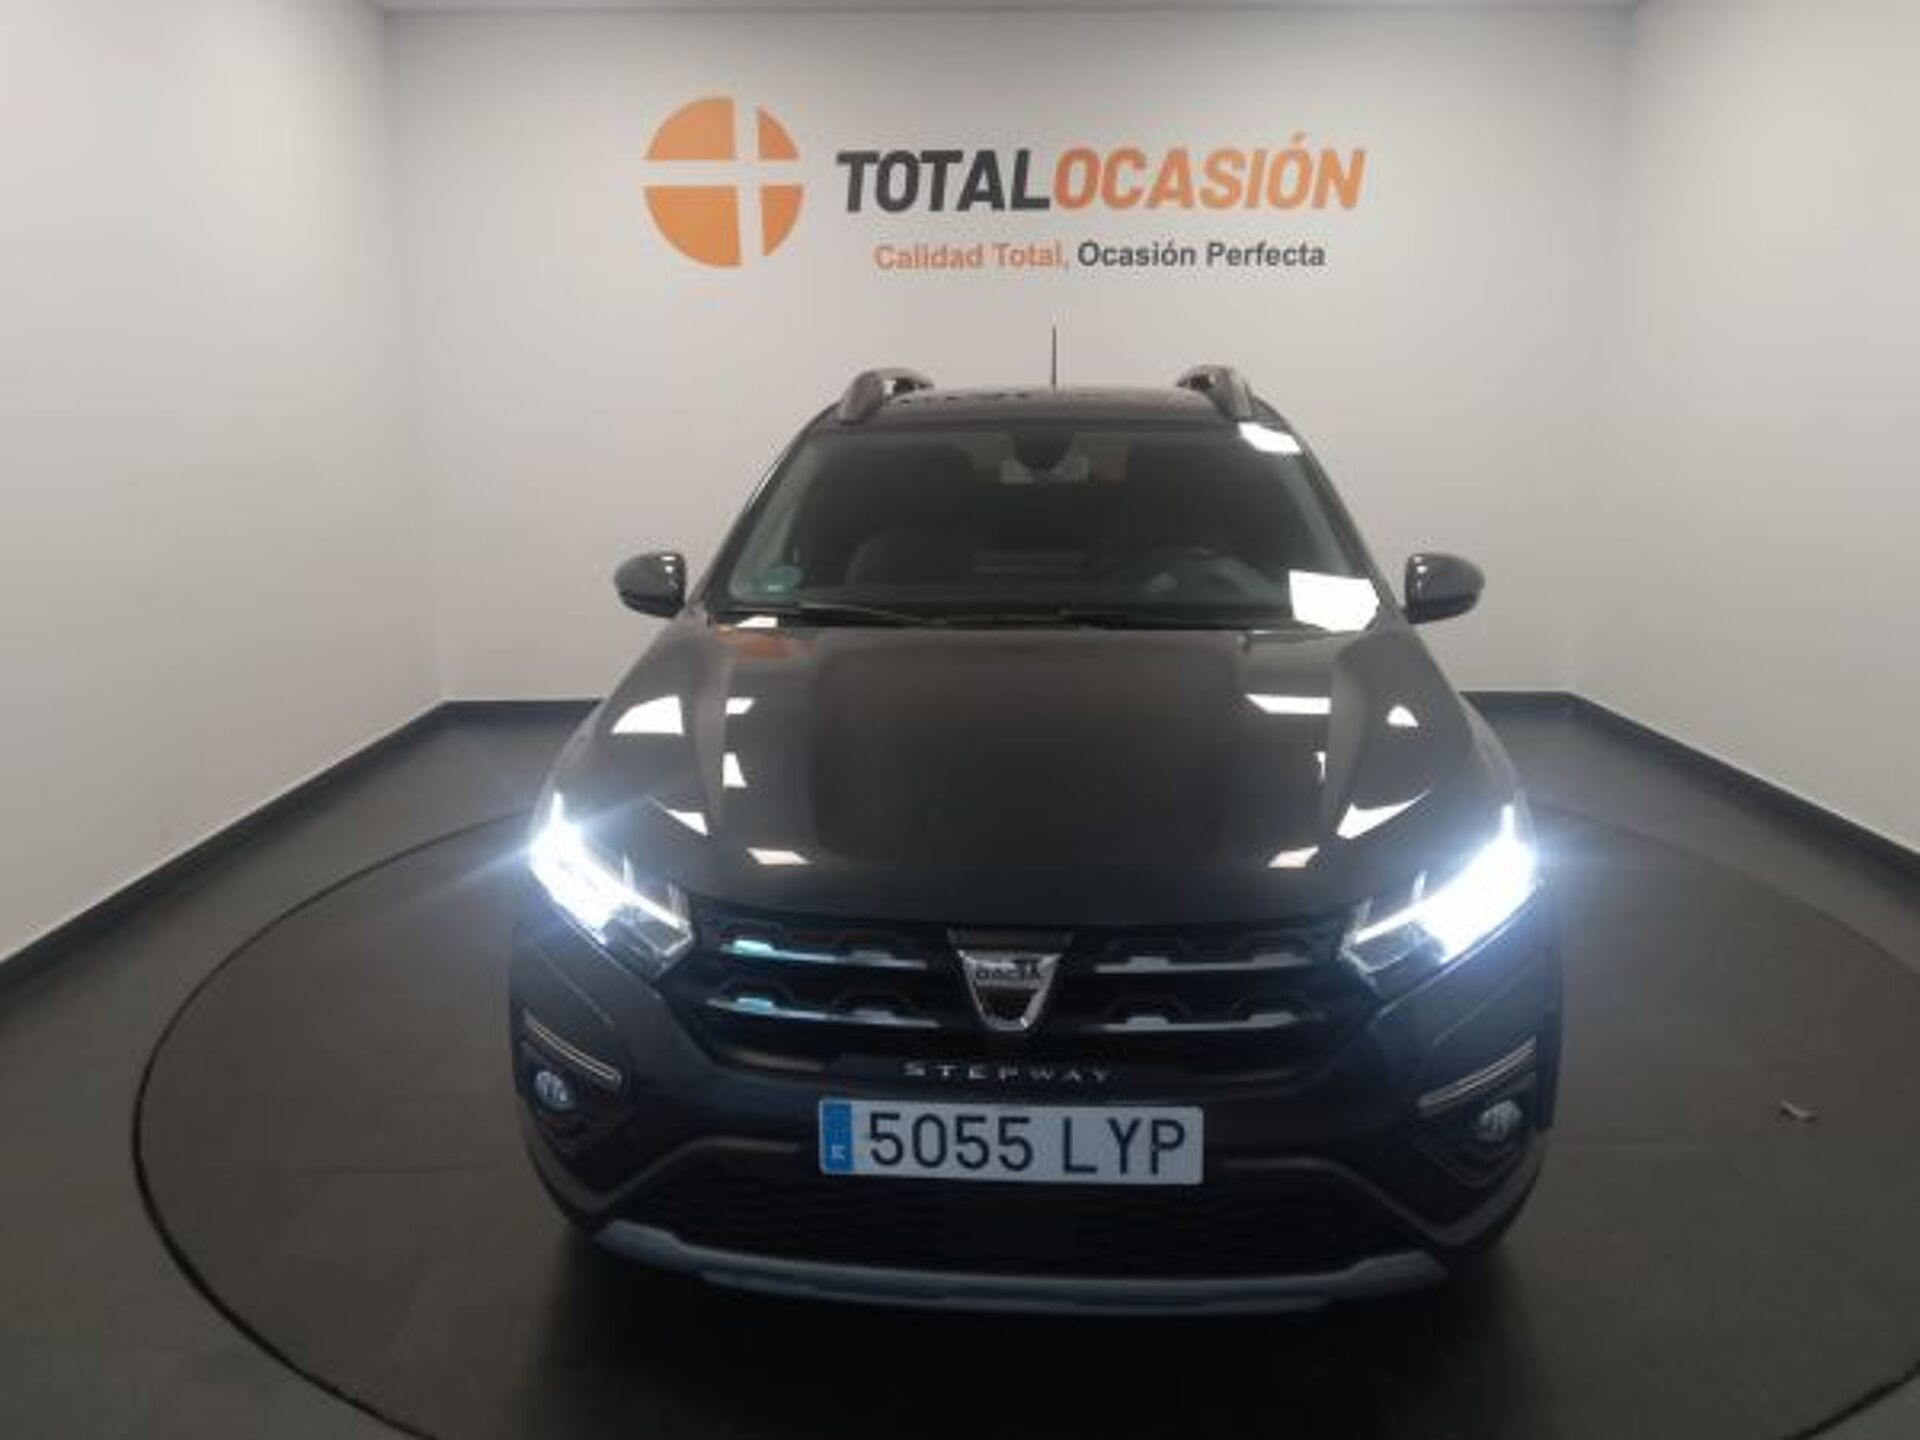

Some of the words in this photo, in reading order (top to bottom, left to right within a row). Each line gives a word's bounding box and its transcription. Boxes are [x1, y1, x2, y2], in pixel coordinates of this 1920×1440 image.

[874, 242, 984, 269] Calidad
[993, 242, 1070, 271] Total,
[1077, 239, 1197, 267] Ocasión
[1206, 241, 1326, 267] Perfecta
[903, 1061, 1110, 1082] STEPWAY
[869, 1112, 1034, 1172] 5055
[1062, 1116, 1186, 1176] LYP
